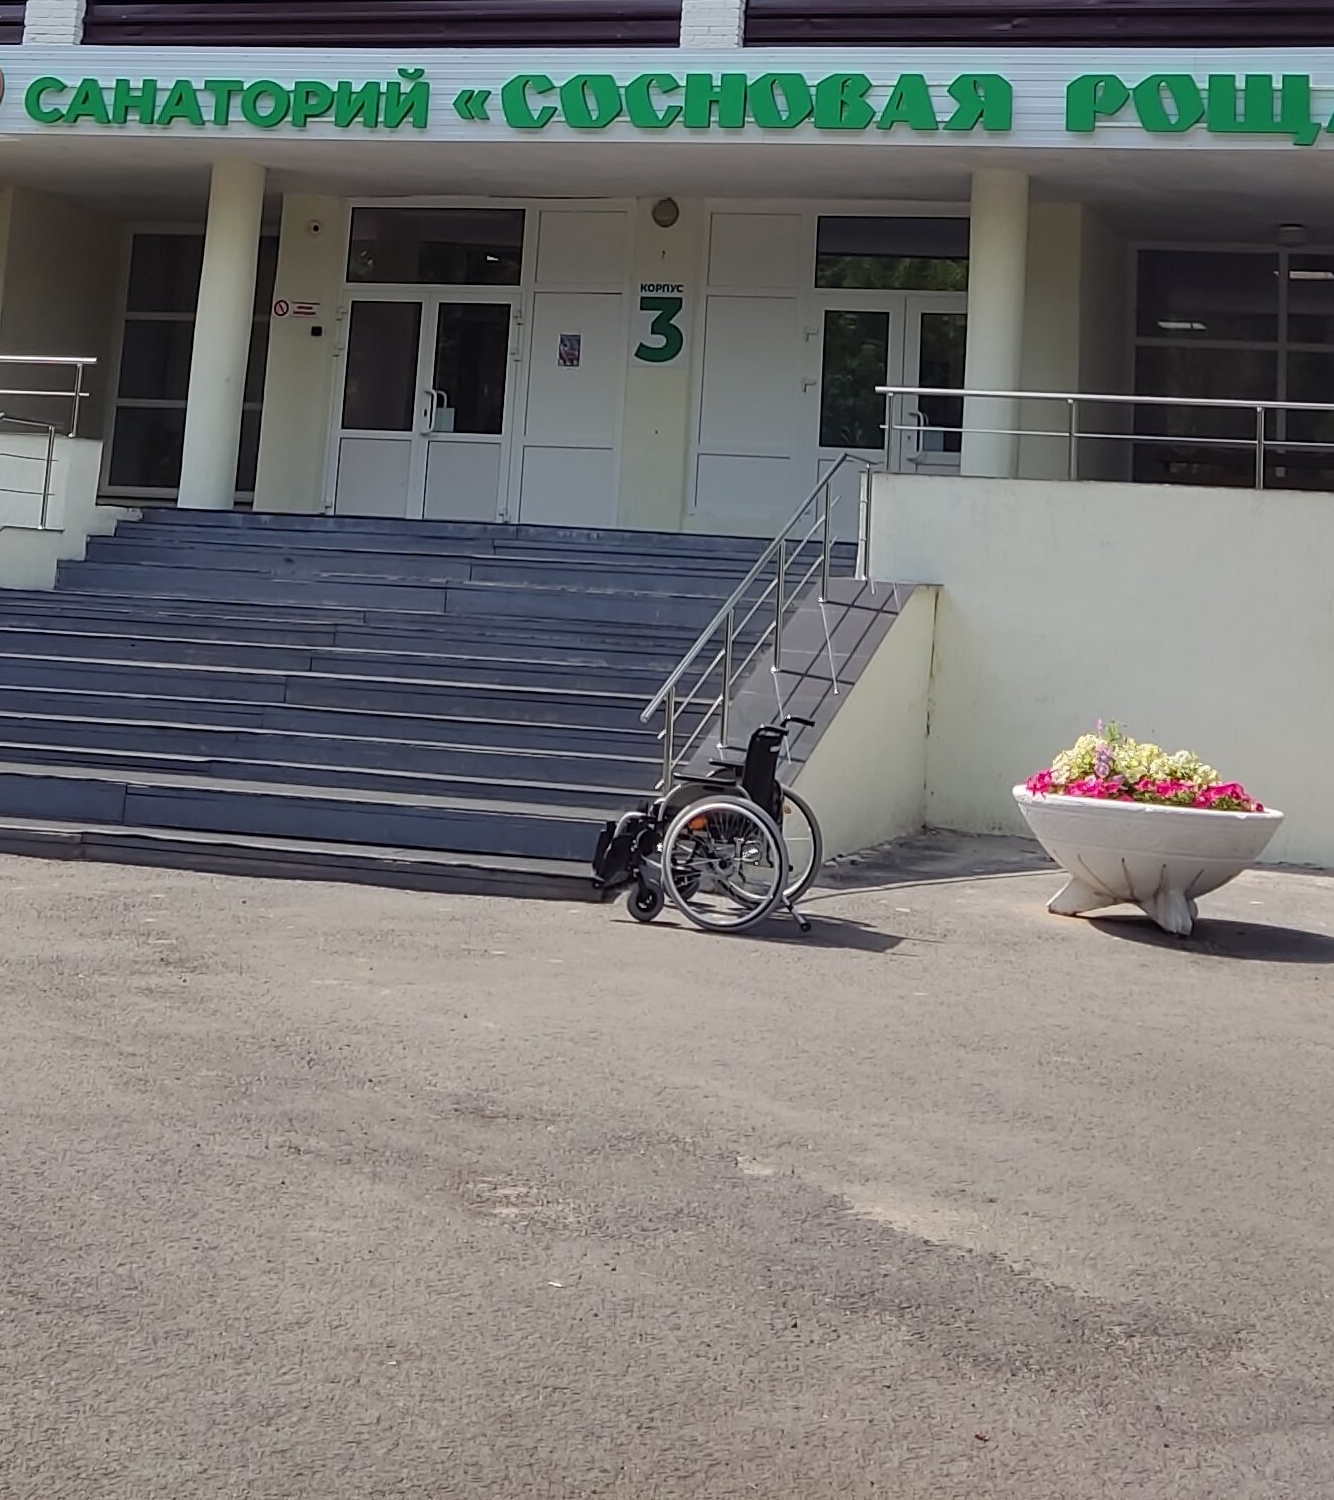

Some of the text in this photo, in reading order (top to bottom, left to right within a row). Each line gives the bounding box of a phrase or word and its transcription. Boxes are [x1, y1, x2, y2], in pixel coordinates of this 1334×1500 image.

[24, 67, 430, 129] САНАТОРИЙ
[452, 73, 1013, 131] «СОСНОВАЯ
[640, 283, 684, 293] КОРПУС
[634, 296, 684, 363] 3
